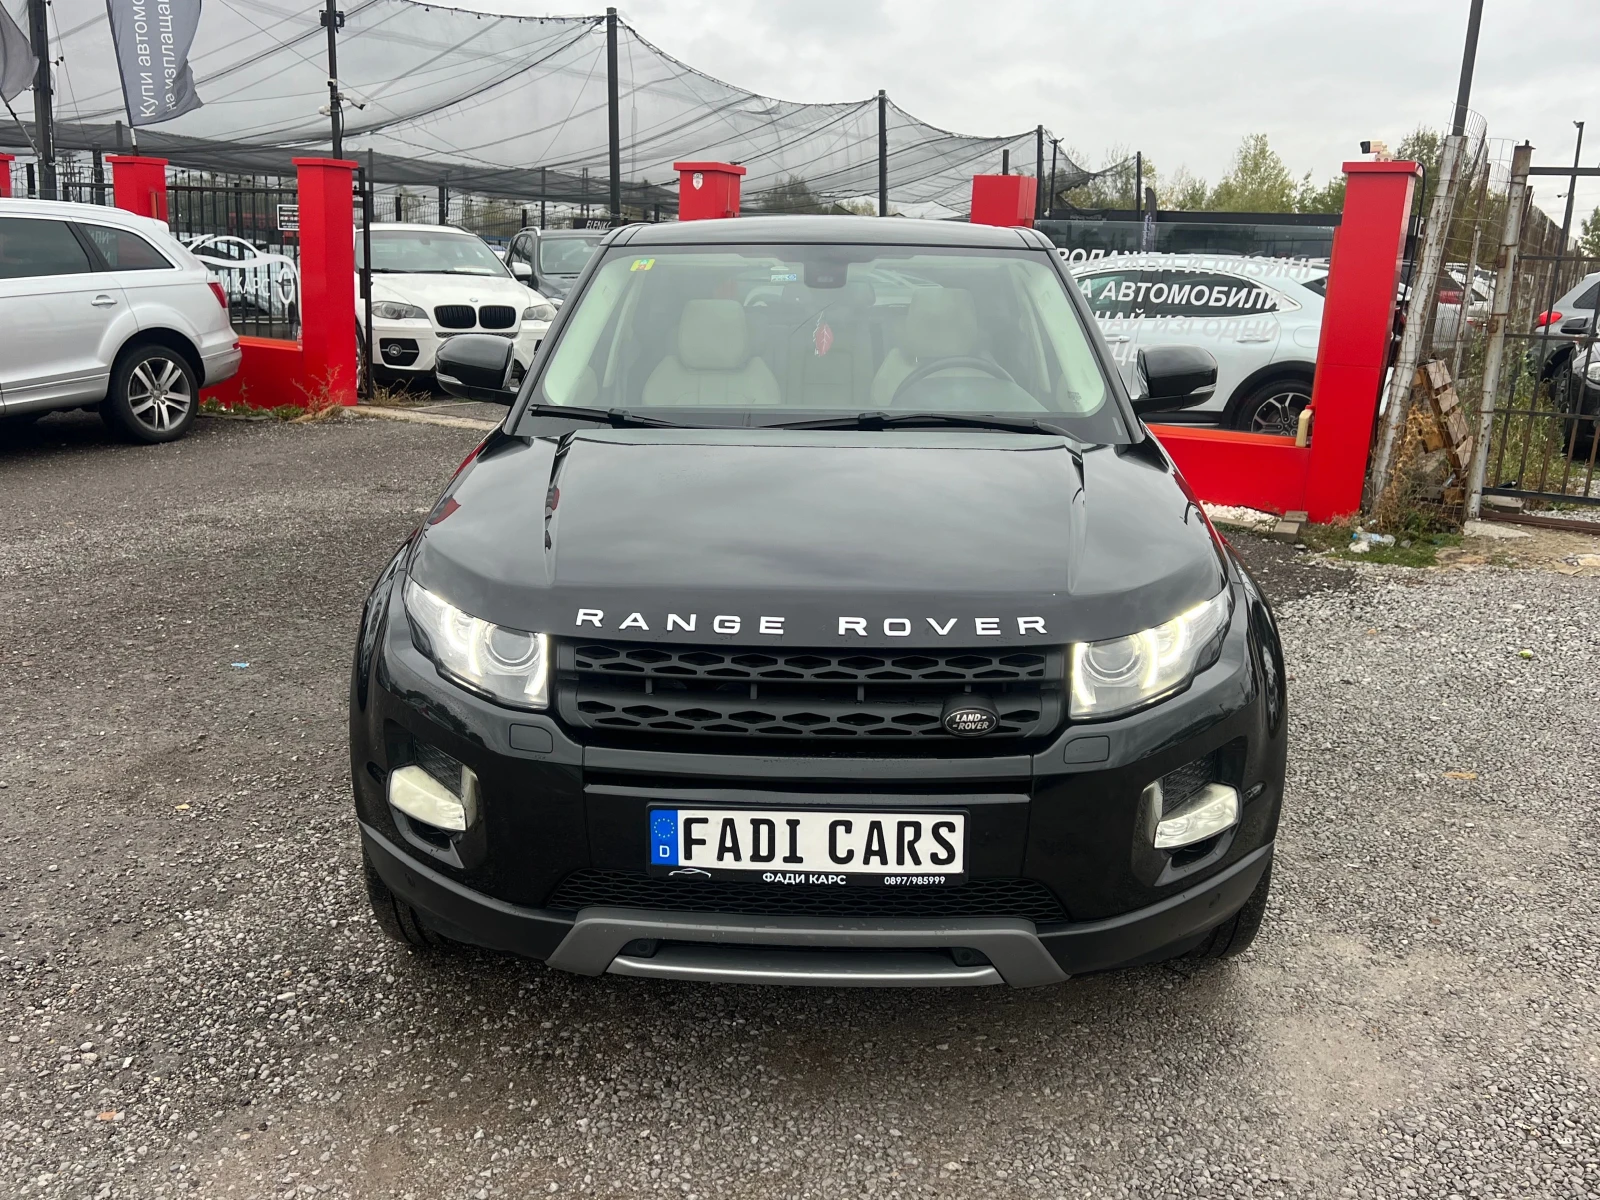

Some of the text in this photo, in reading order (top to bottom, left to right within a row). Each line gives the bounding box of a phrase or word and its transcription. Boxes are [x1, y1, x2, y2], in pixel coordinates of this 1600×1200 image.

[140, 72, 159, 117] Купи
[1056, 247, 1176, 273] РОДАЖБА
[1208, 255, 1326, 279] ЛИЗИНГ
[235, 276, 271, 298] КАРС
[1075, 278, 1286, 311] А АВТОМОБИЛИ
[575, 608, 1049, 637] RANGE ROVER
[659, 816, 957, 867] D FADI CARS
[762, 872, 946, 886] ФАДИ КАРС 0897/985999
